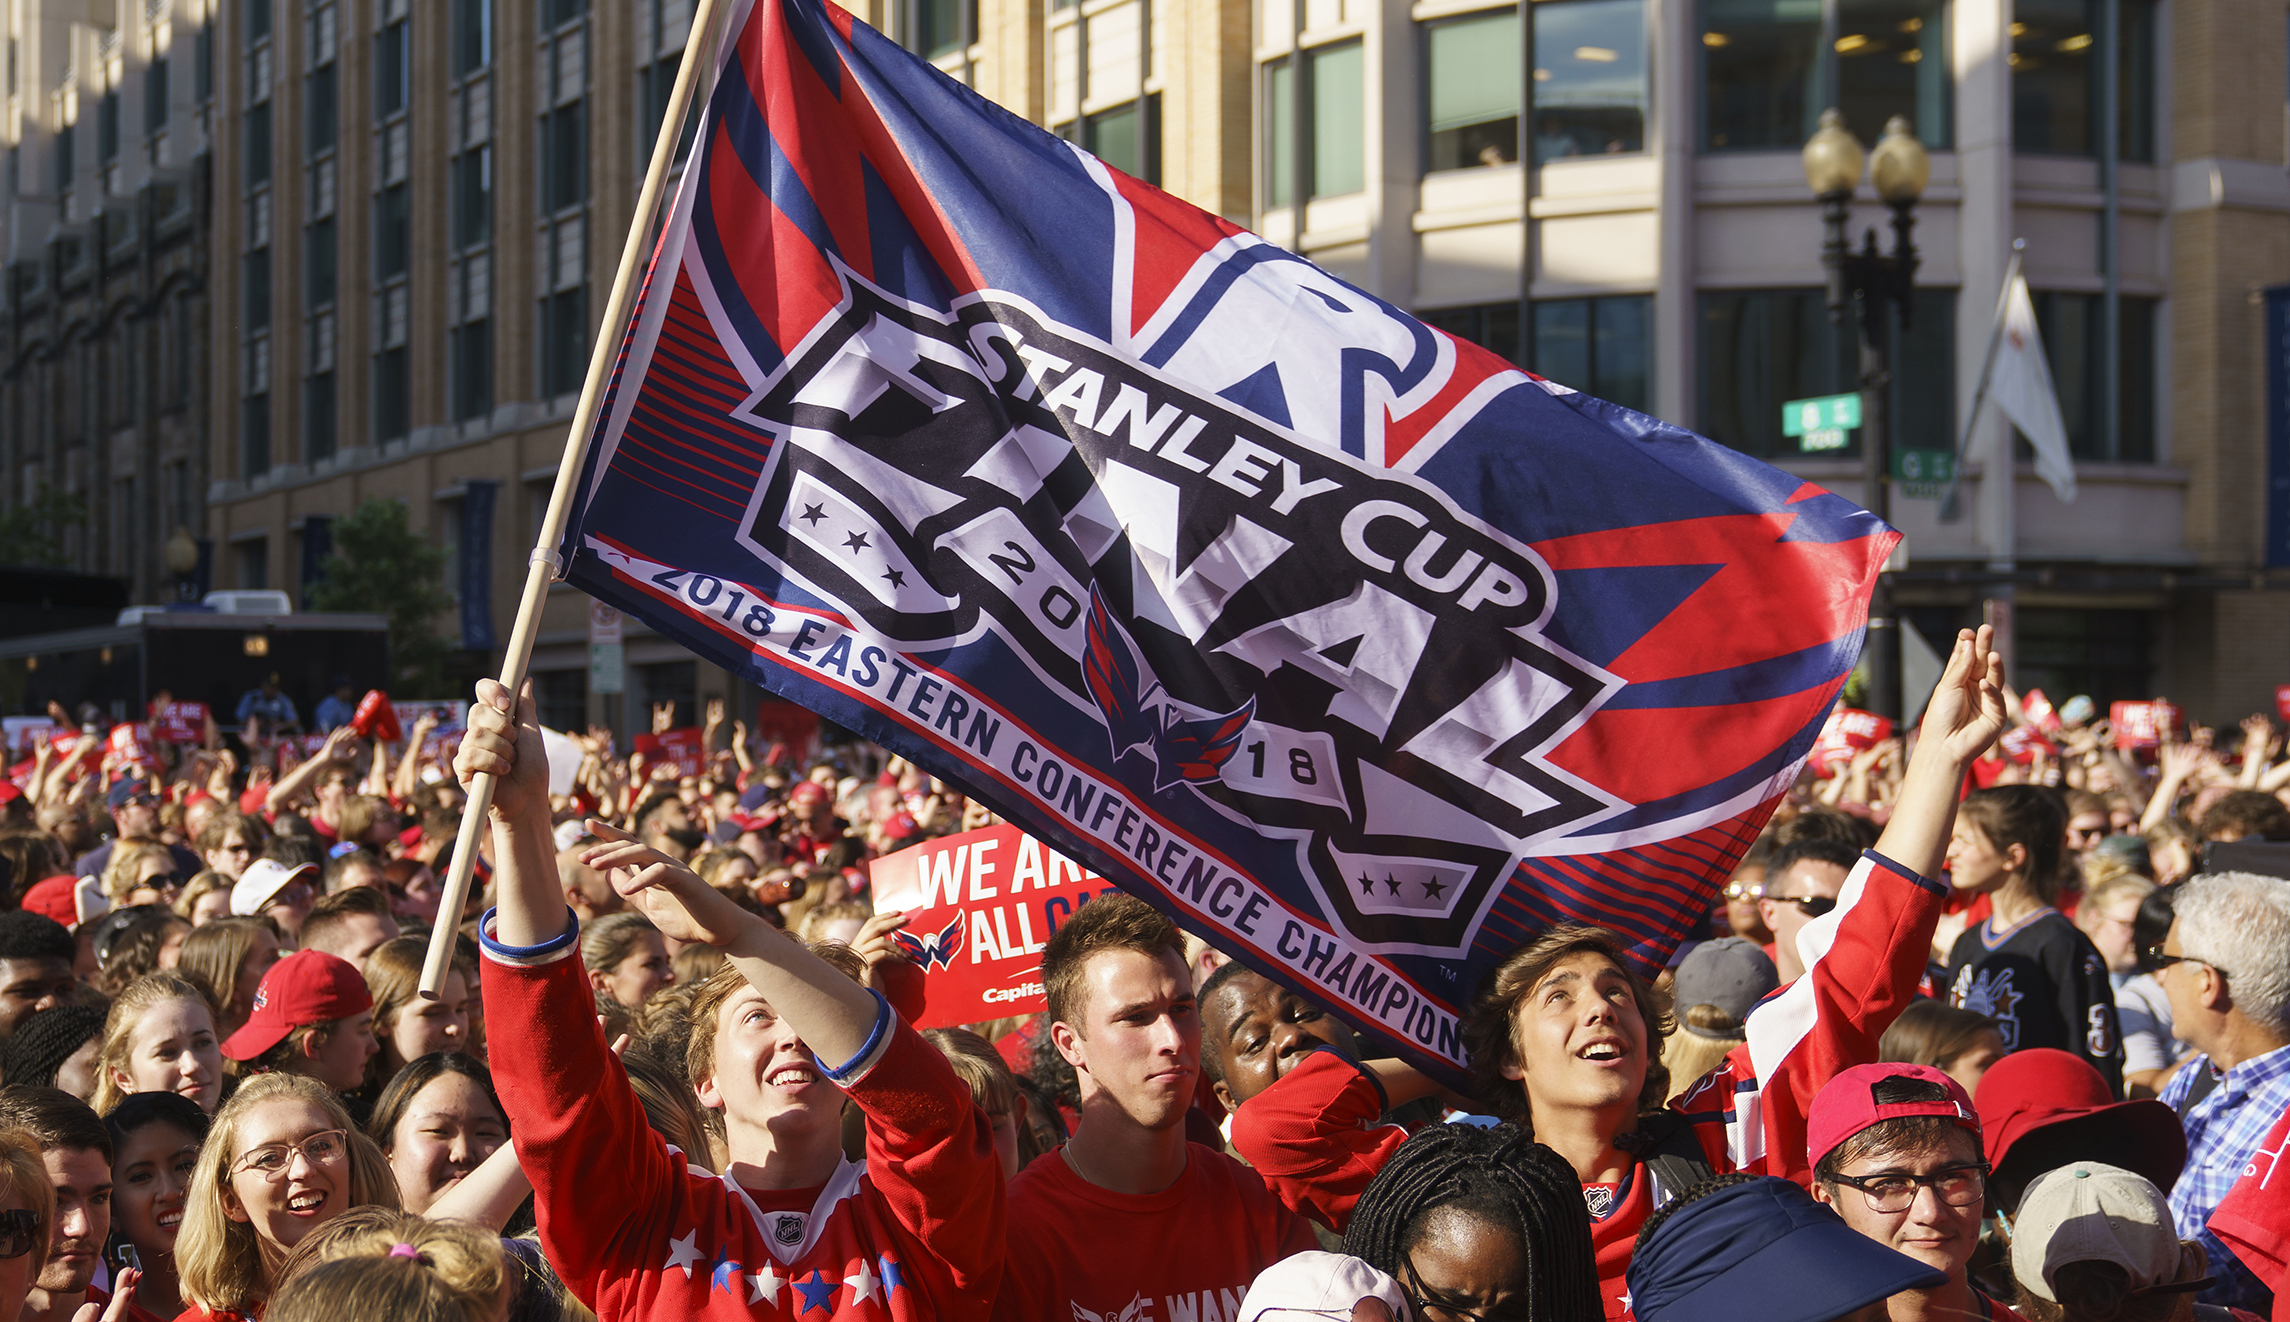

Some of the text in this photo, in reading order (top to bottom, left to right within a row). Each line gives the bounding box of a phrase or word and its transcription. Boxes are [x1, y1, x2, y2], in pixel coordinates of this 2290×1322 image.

[966, 322, 1528, 612] STANLEY CUP
[788, 311, 1561, 817] FINAL
[651, 569, 1474, 1067] 2018 EASTERN CONFERENCE CHAMPION
[917, 832, 1101, 910] WE AR
[971, 902, 1047, 964] ALL
[982, 982, 1047, 1003] Capita
[1439, 964, 1457, 983] TM
[1590, 1194, 1607, 1211] NHL
[781, 1223, 798, 1237] NHL
[1165, 1285, 1249, 1322] WAN
